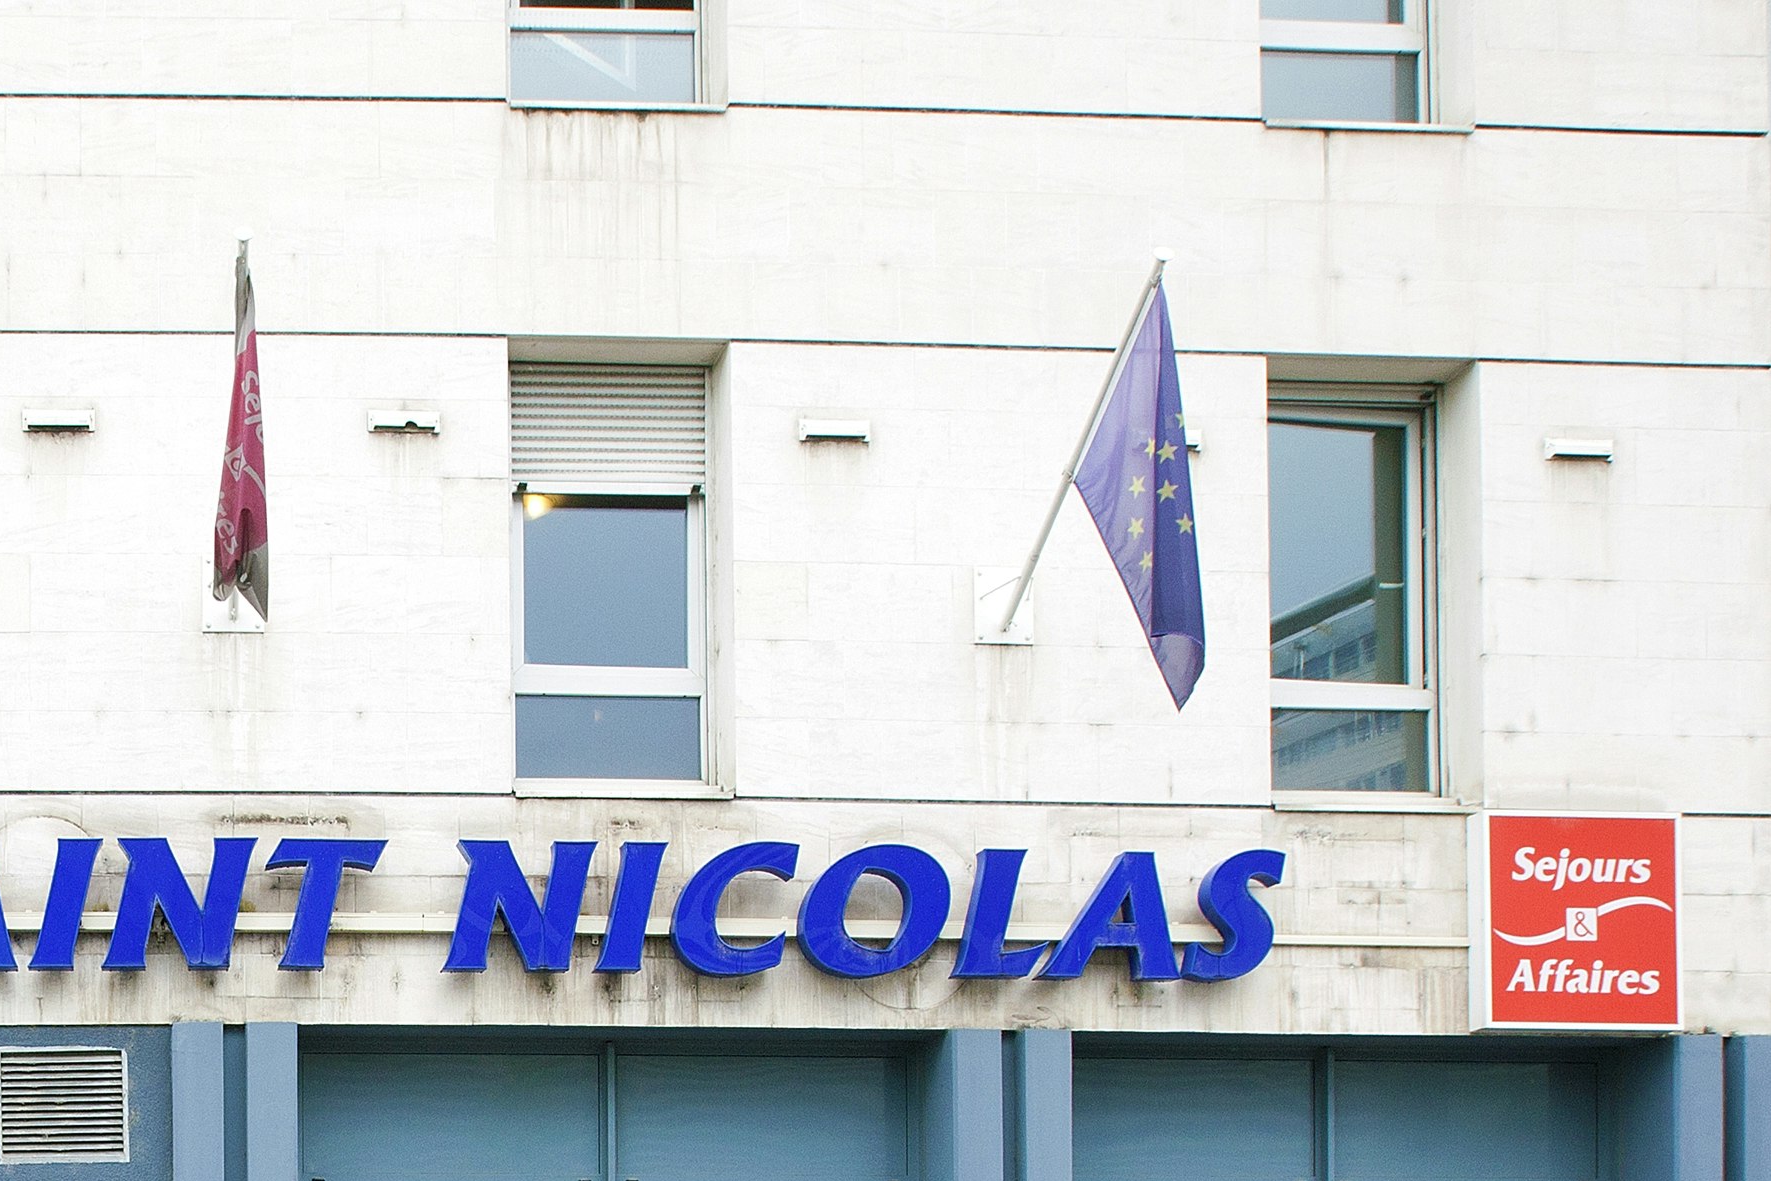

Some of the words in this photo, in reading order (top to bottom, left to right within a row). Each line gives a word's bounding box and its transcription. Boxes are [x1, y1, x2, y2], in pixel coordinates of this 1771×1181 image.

[1511, 846, 1652, 891] Sejours
[440, 838, 1286, 983] NICOLAS
[1573, 910, 1594, 938] &
[1505, 958, 1661, 996] Affaires
